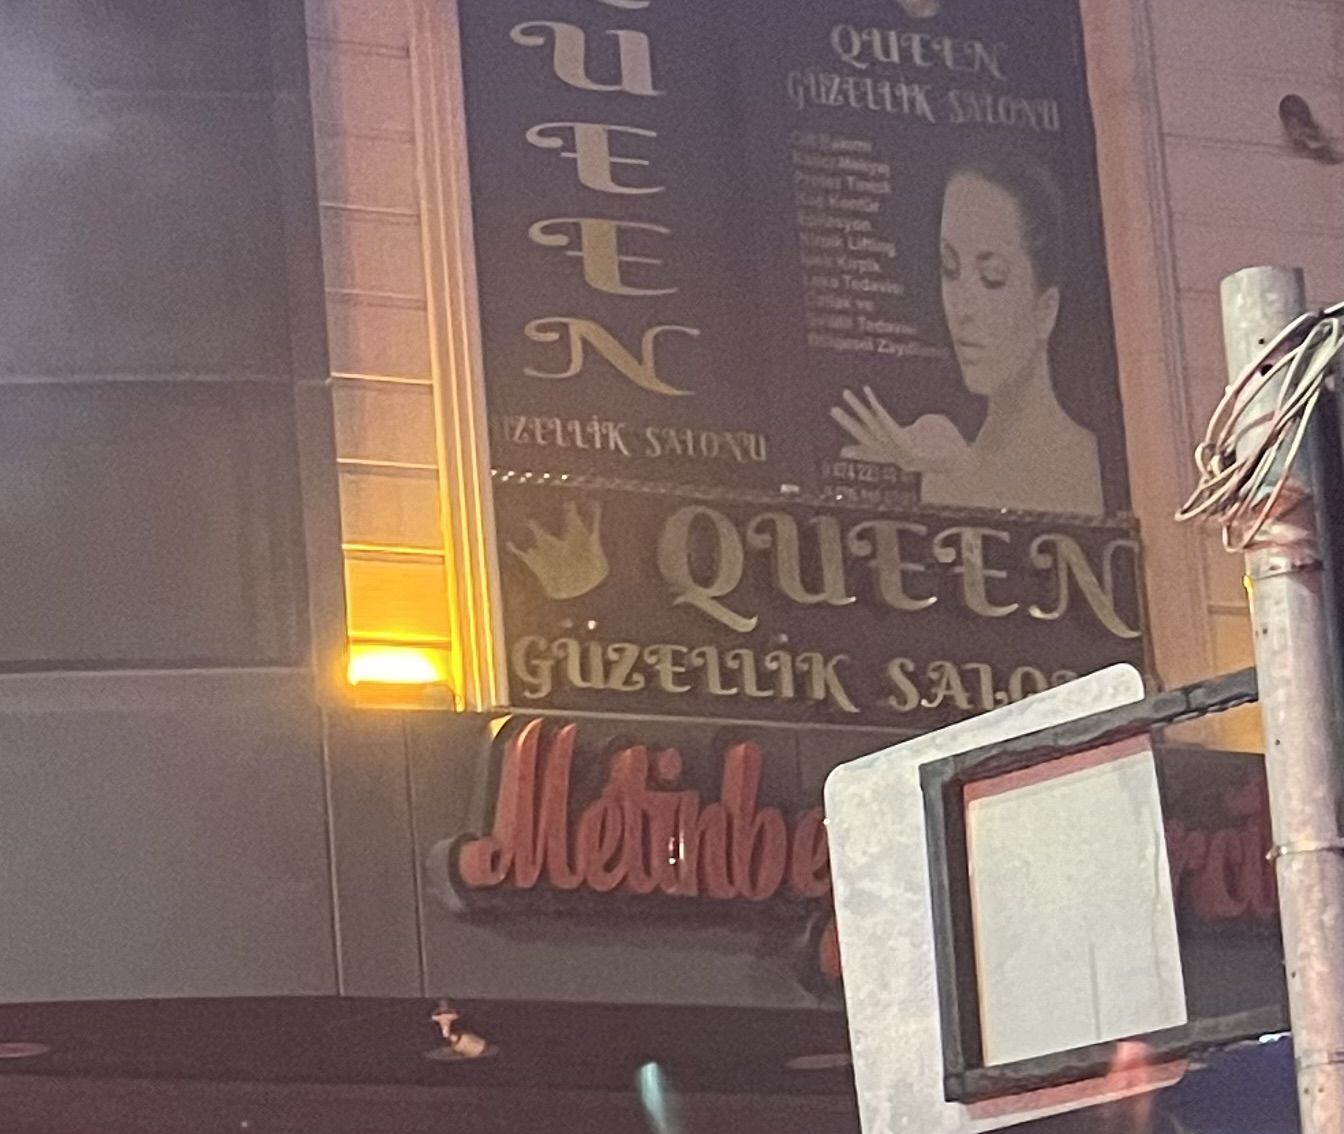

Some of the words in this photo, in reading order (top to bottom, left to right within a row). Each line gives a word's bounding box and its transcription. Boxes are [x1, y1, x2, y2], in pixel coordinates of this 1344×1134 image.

[830, 23, 1010, 81] QUEEN
[510, 0, 701, 395] UEEN
[656, 504, 1143, 639] QUEEN
[511, 616, 861, 714] GÜZELLİK
[459, 718, 840, 980] Metinbe
